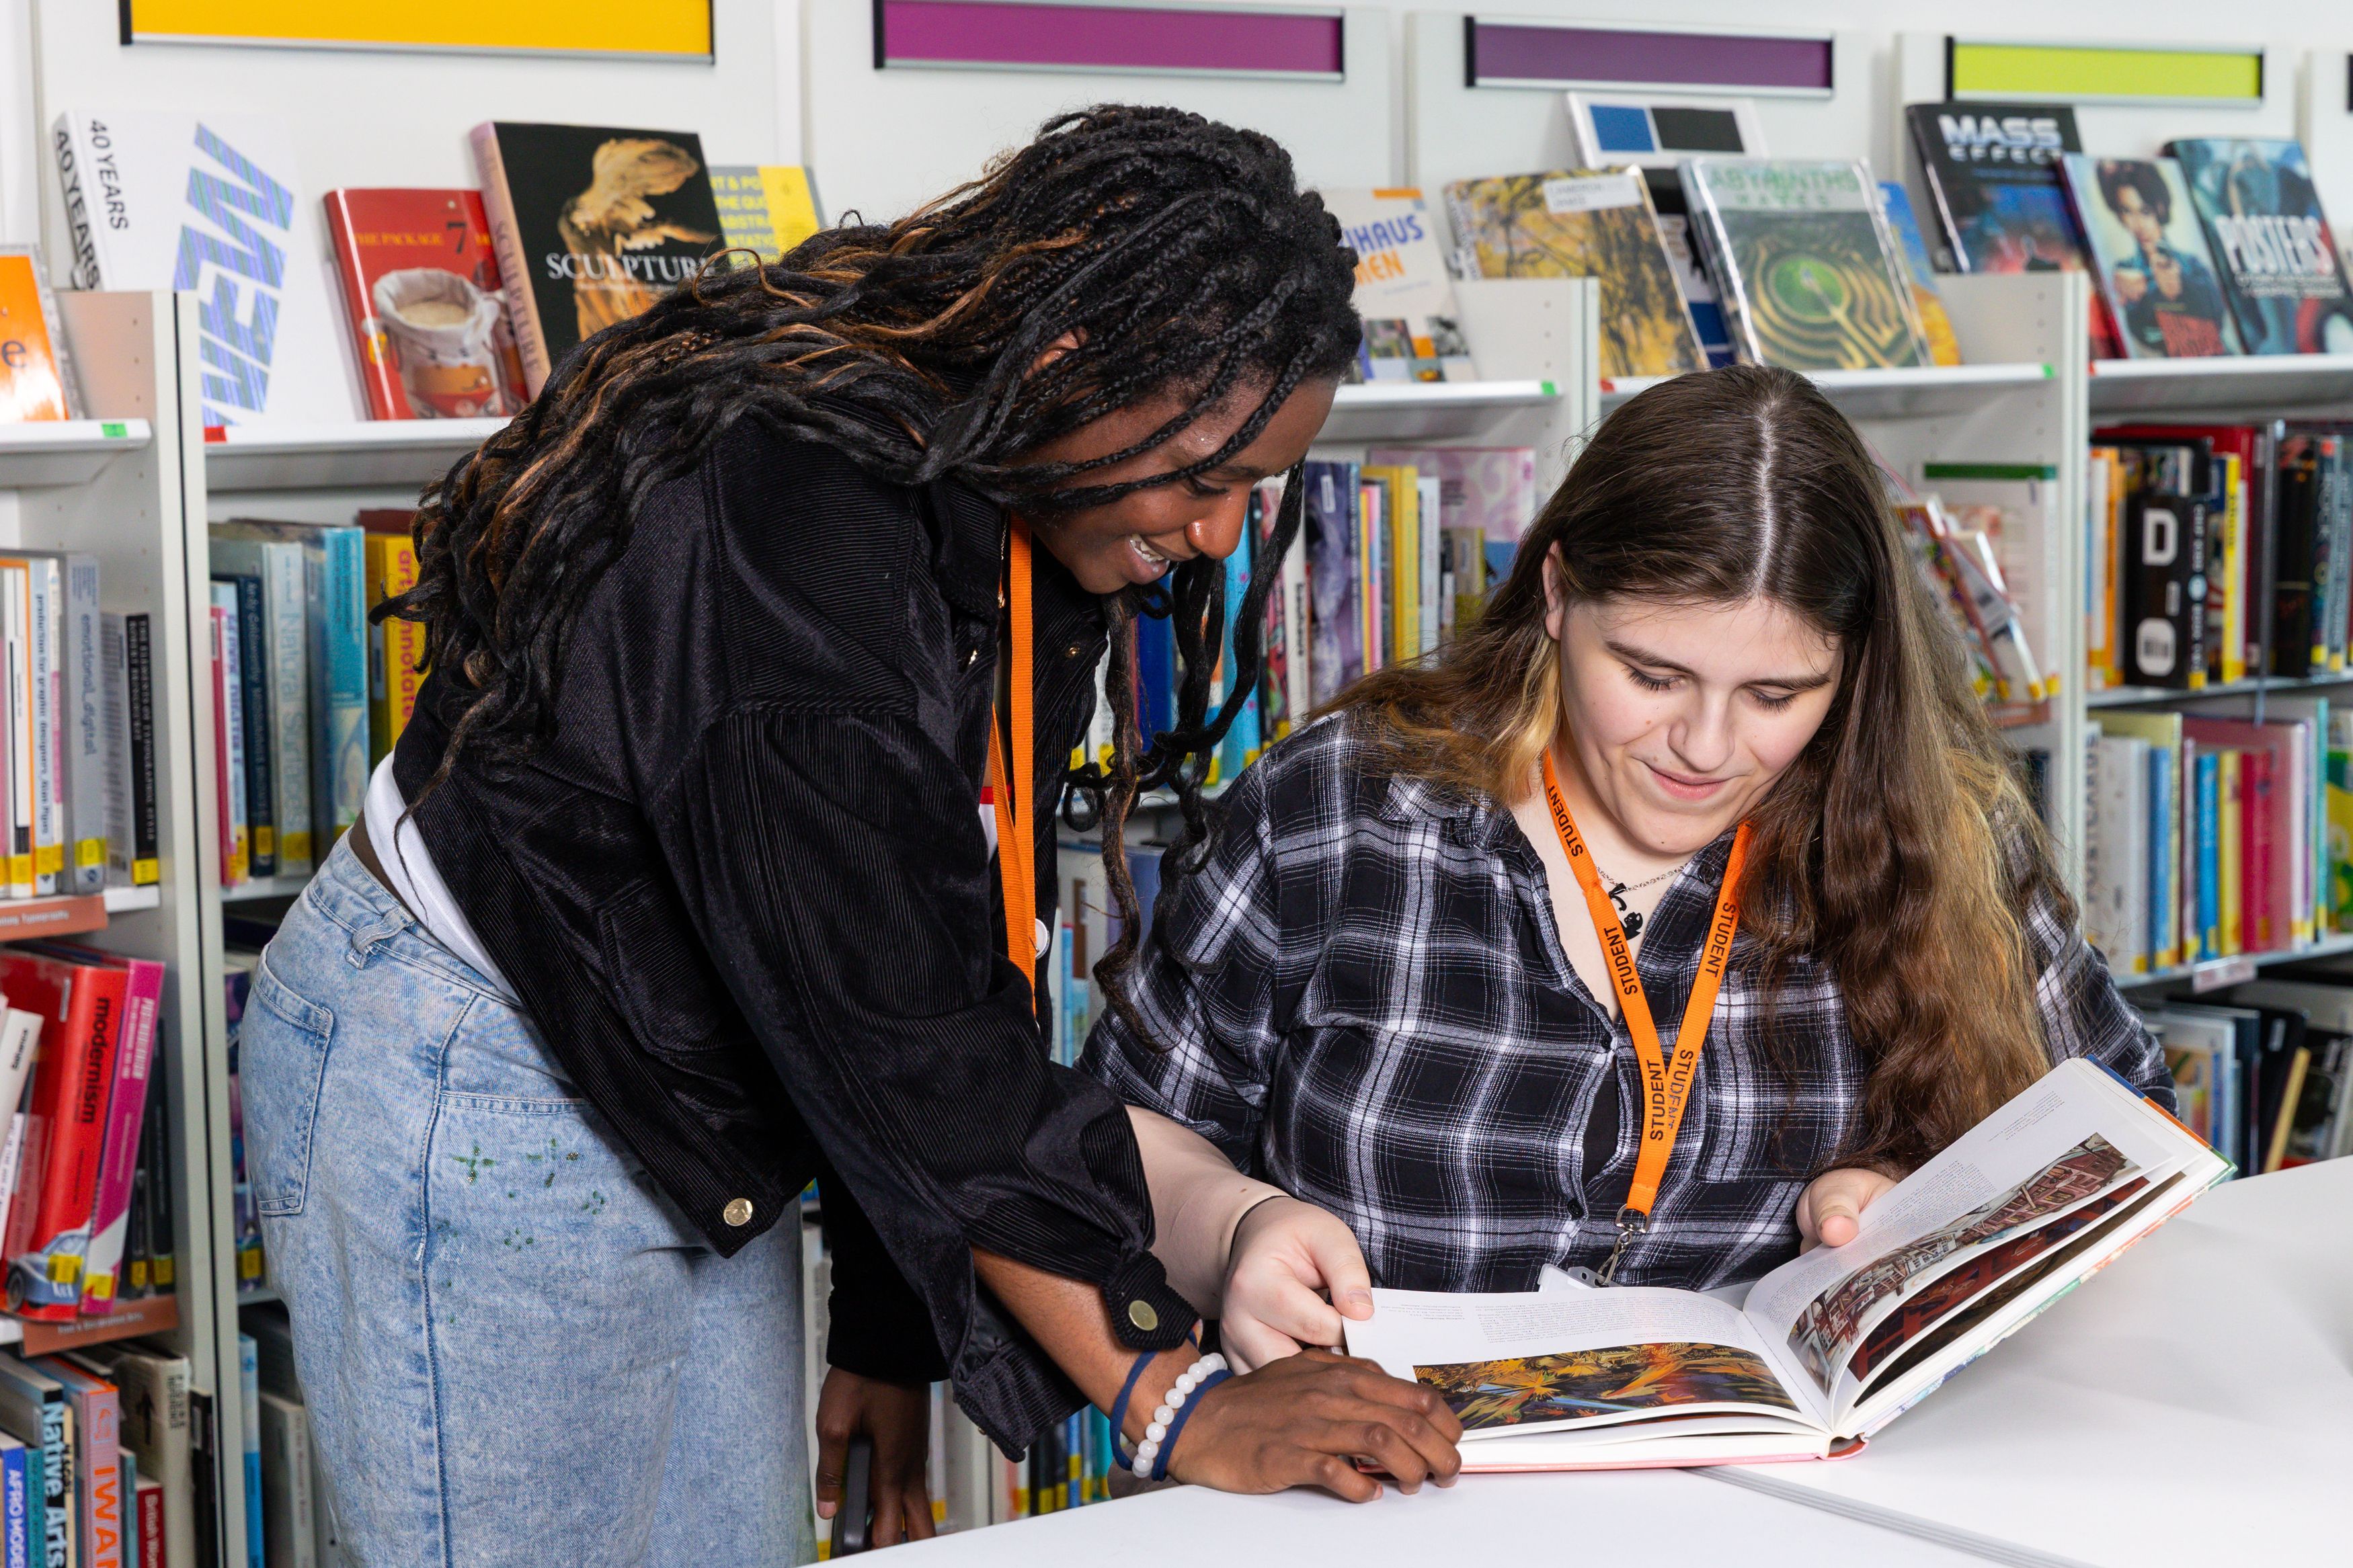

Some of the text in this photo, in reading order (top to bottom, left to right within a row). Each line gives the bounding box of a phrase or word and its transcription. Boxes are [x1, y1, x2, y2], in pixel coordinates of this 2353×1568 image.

[1938, 114, 2062, 149] MASS
[88, 119, 128, 231] 40 YEARS
[446, 220, 467, 255] 7
[2216, 214, 2335, 276] POSTERS
[278, 612, 309, 829] Natural Surfaces
[1548, 785, 1583, 857] STUDENT
[1603, 926, 1638, 996] STUDENT
[1705, 901, 1736, 979] STUDENT
[80, 997, 111, 1124] modernism
[1646, 1059, 1665, 1141] STUDENT
[43, 1402, 66, 1497] Native
[7, 1469, 24, 1517] AFRO
[94, 1466, 118, 1568] IWA
[145, 1495, 159, 1538] British
[44, 1506, 67, 1567] Arts
